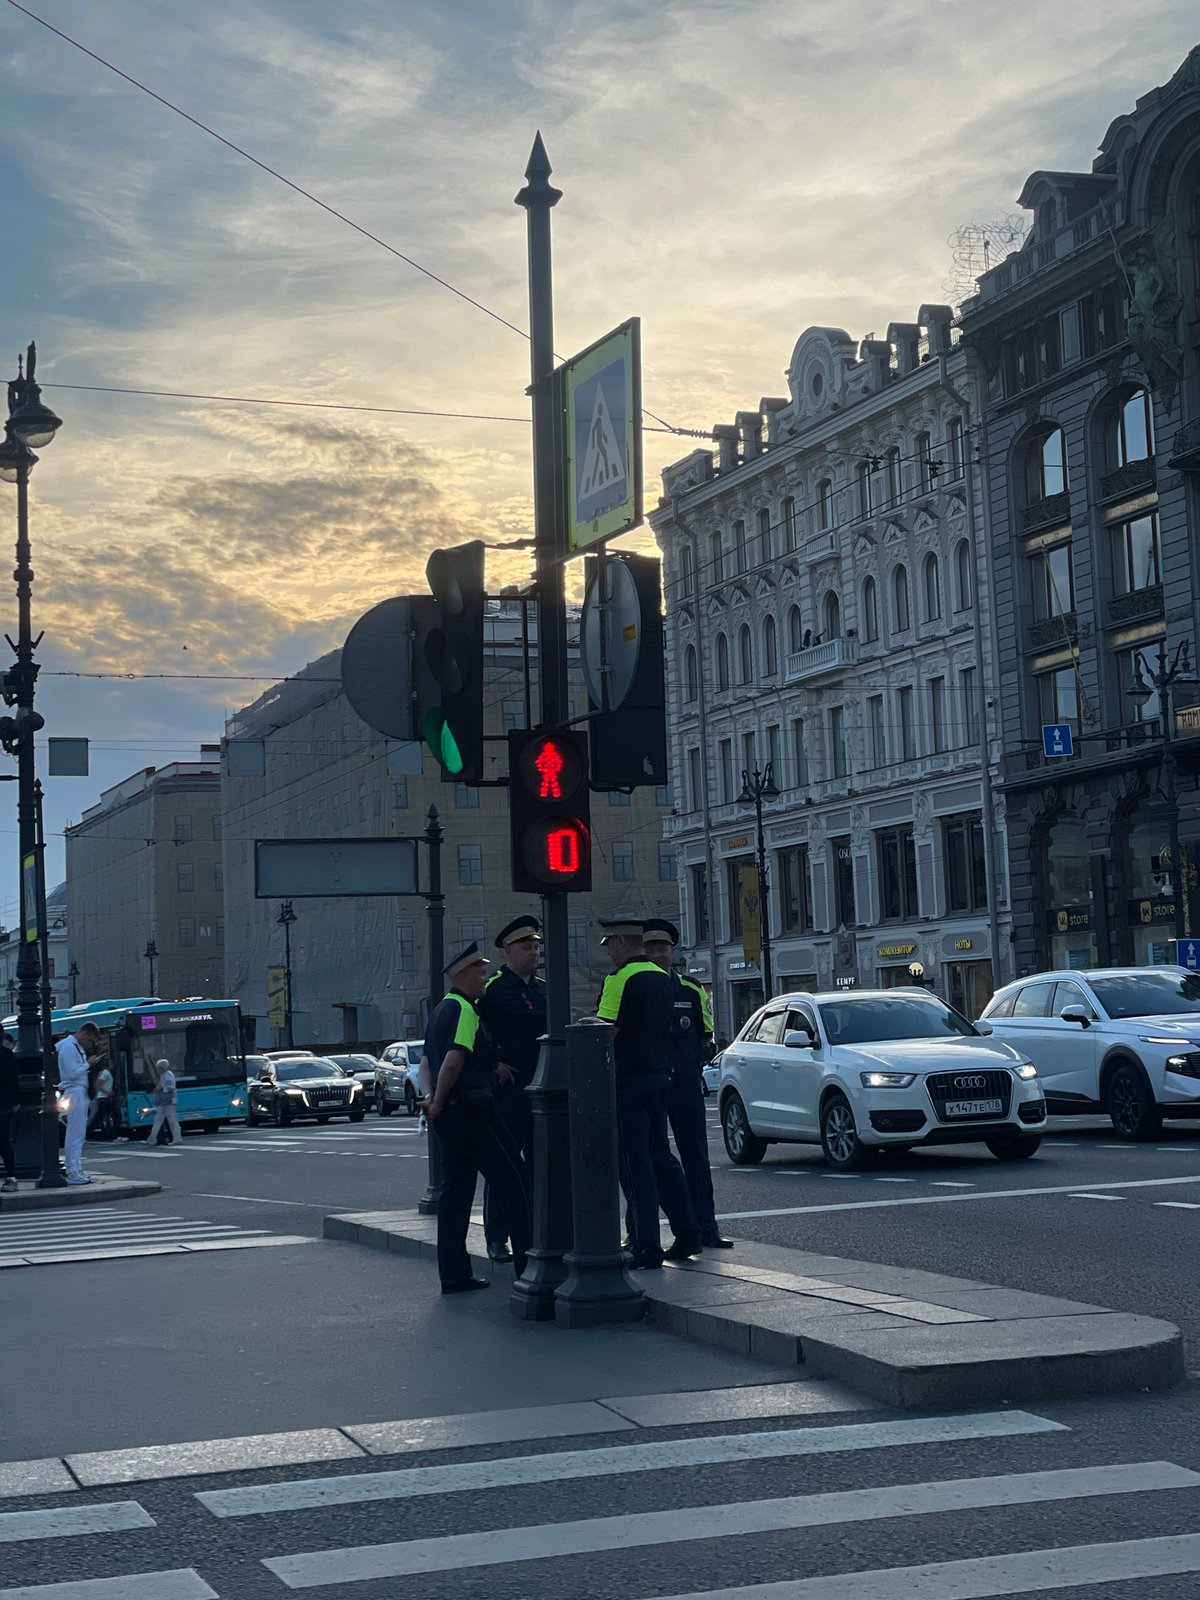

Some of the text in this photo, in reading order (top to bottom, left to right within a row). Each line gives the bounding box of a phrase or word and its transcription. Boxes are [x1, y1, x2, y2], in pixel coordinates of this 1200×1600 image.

[1153, 903, 1176, 917] store
[1069, 914, 1089, 926] store
[954, 939, 971, 950] НОТЫ
[836, 976, 856, 987] KEMPF
